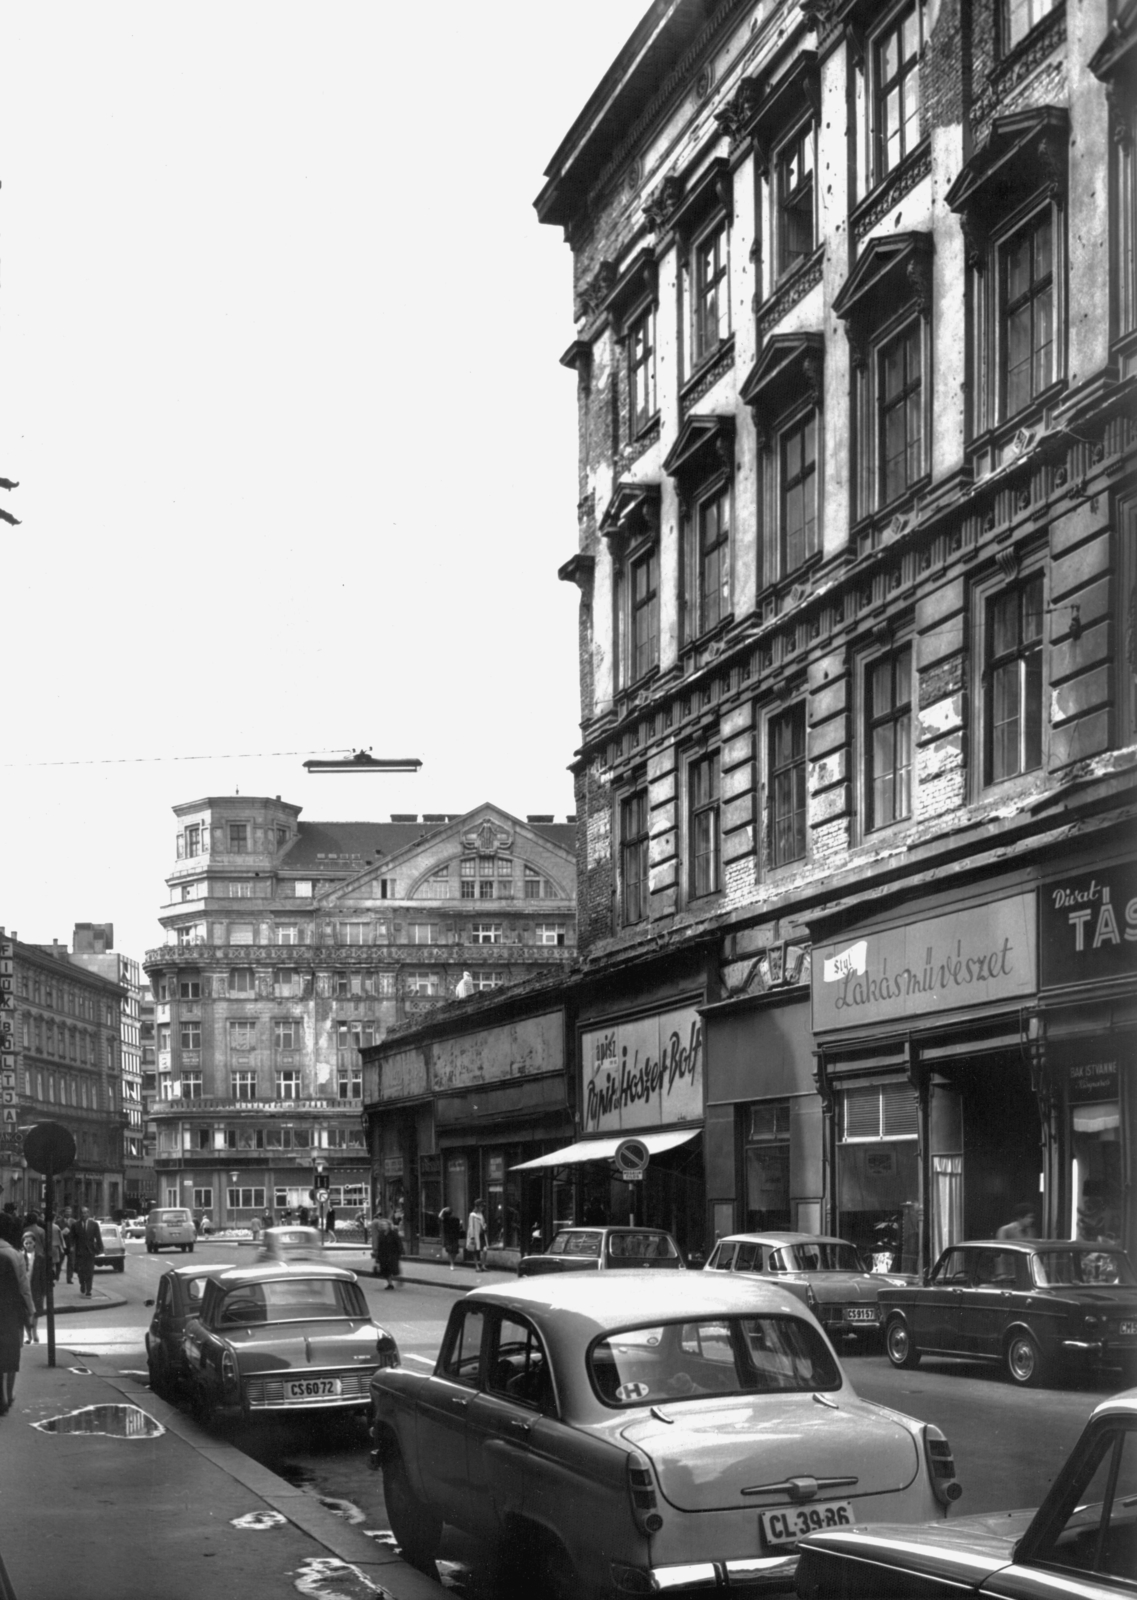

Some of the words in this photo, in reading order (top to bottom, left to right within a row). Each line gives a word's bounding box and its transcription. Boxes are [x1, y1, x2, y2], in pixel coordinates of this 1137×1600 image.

[1052, 880, 1101, 909] Divat
[835, 937, 1014, 1009] Lakásművészet
[622, 1383, 642, 1399] H
